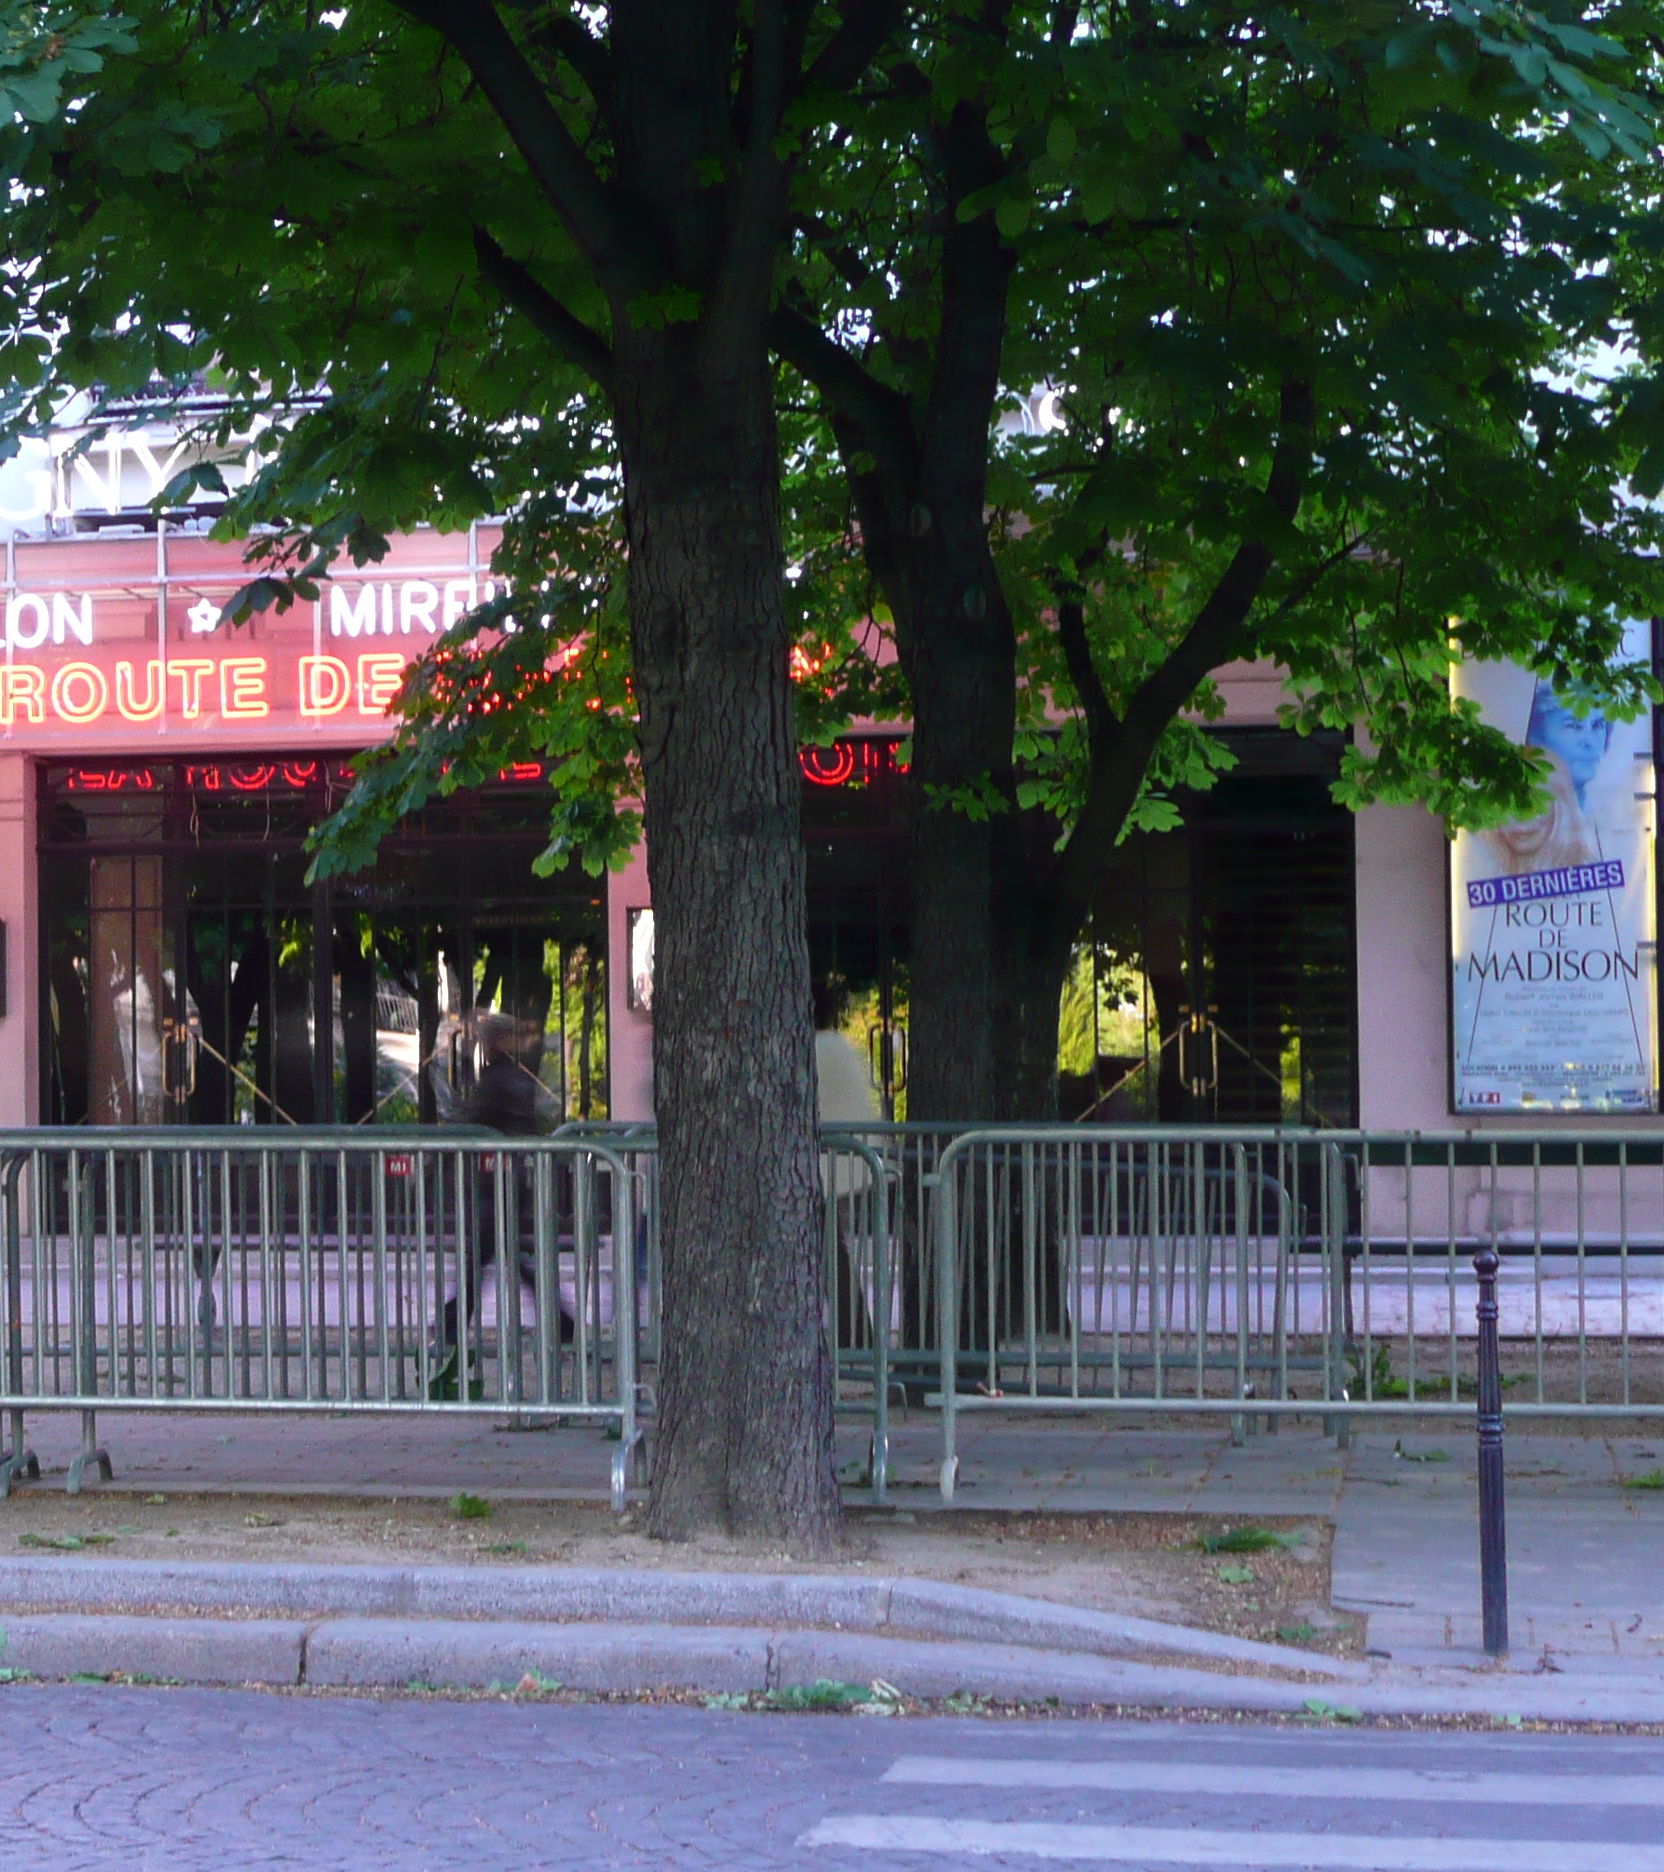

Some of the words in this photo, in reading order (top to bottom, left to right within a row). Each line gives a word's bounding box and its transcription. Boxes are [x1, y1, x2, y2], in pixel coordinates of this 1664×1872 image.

[299, 653, 405, 717] DE
[1469, 882, 1496, 905] 30
[1502, 863, 1622, 901] DERNIÈRES
[1506, 902, 1603, 928] ROUTE
[1539, 928, 1568, 949] DE
[1468, 949, 1639, 983] MADISON
